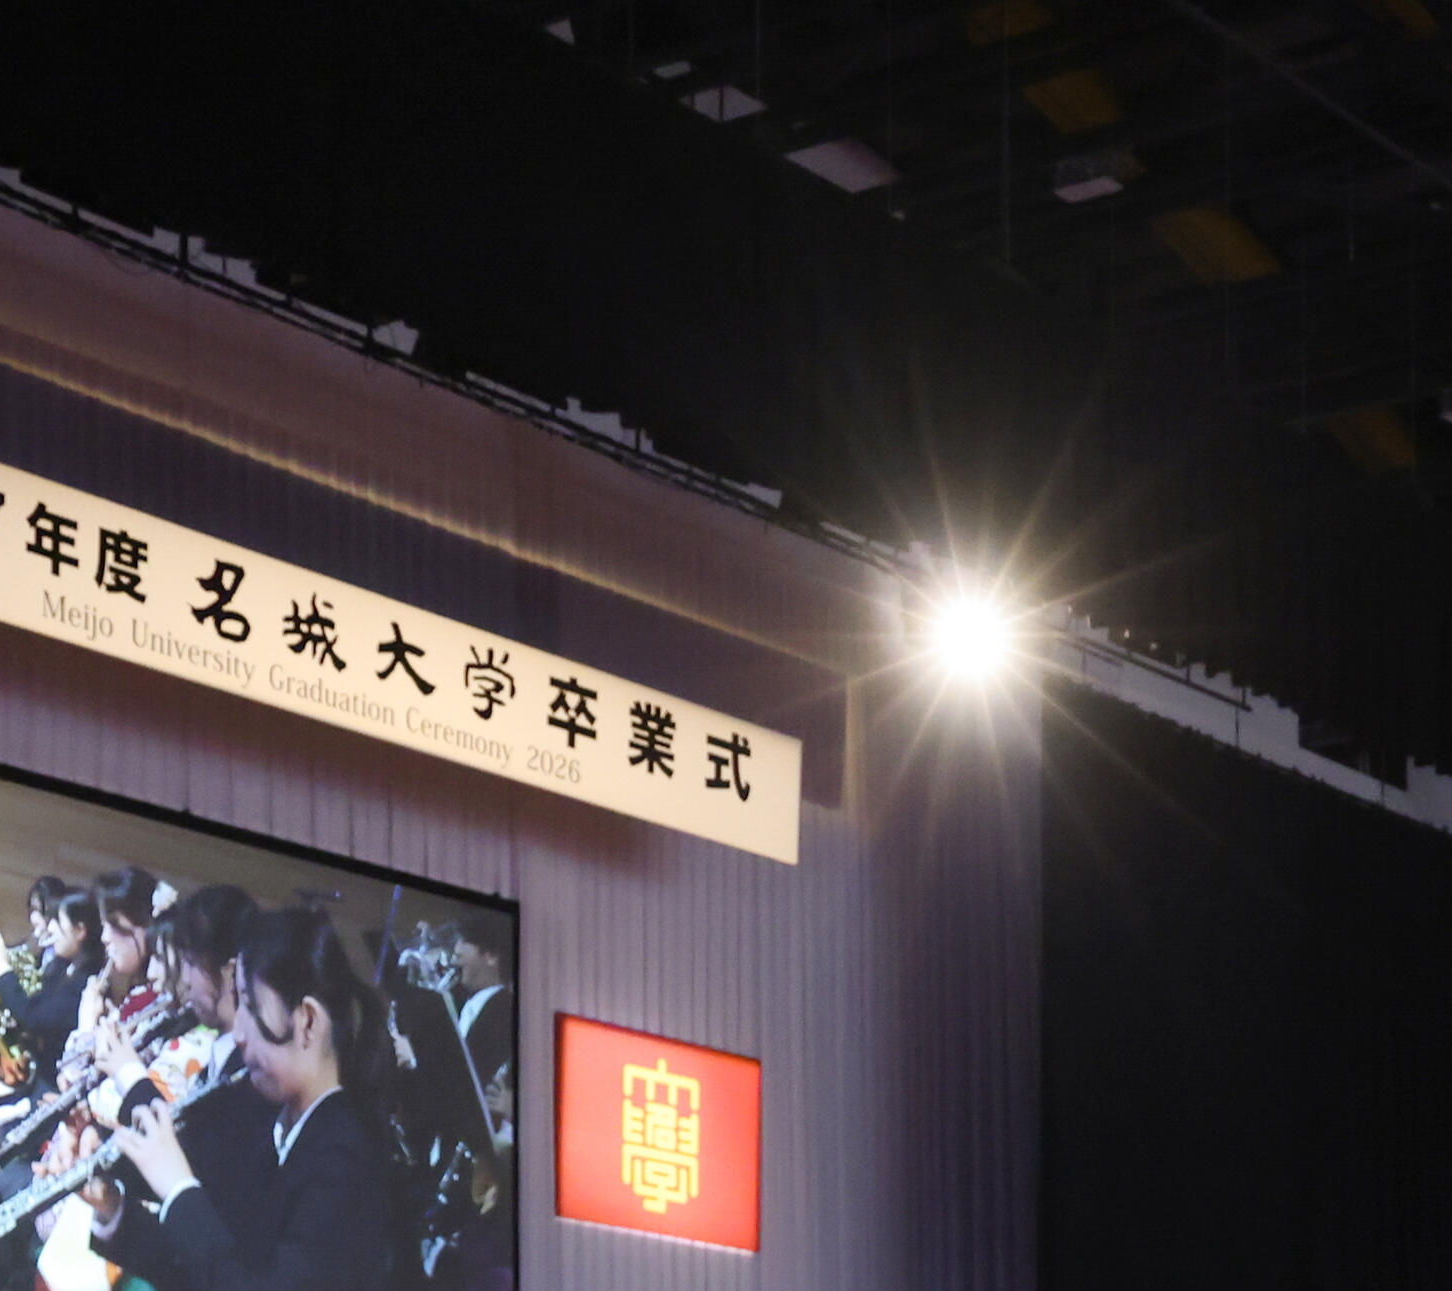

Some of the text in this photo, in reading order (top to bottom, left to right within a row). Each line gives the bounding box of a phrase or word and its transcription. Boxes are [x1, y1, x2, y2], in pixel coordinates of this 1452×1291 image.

[41, 588, 582, 785] Meijo University Graduation Ceremony 2026
